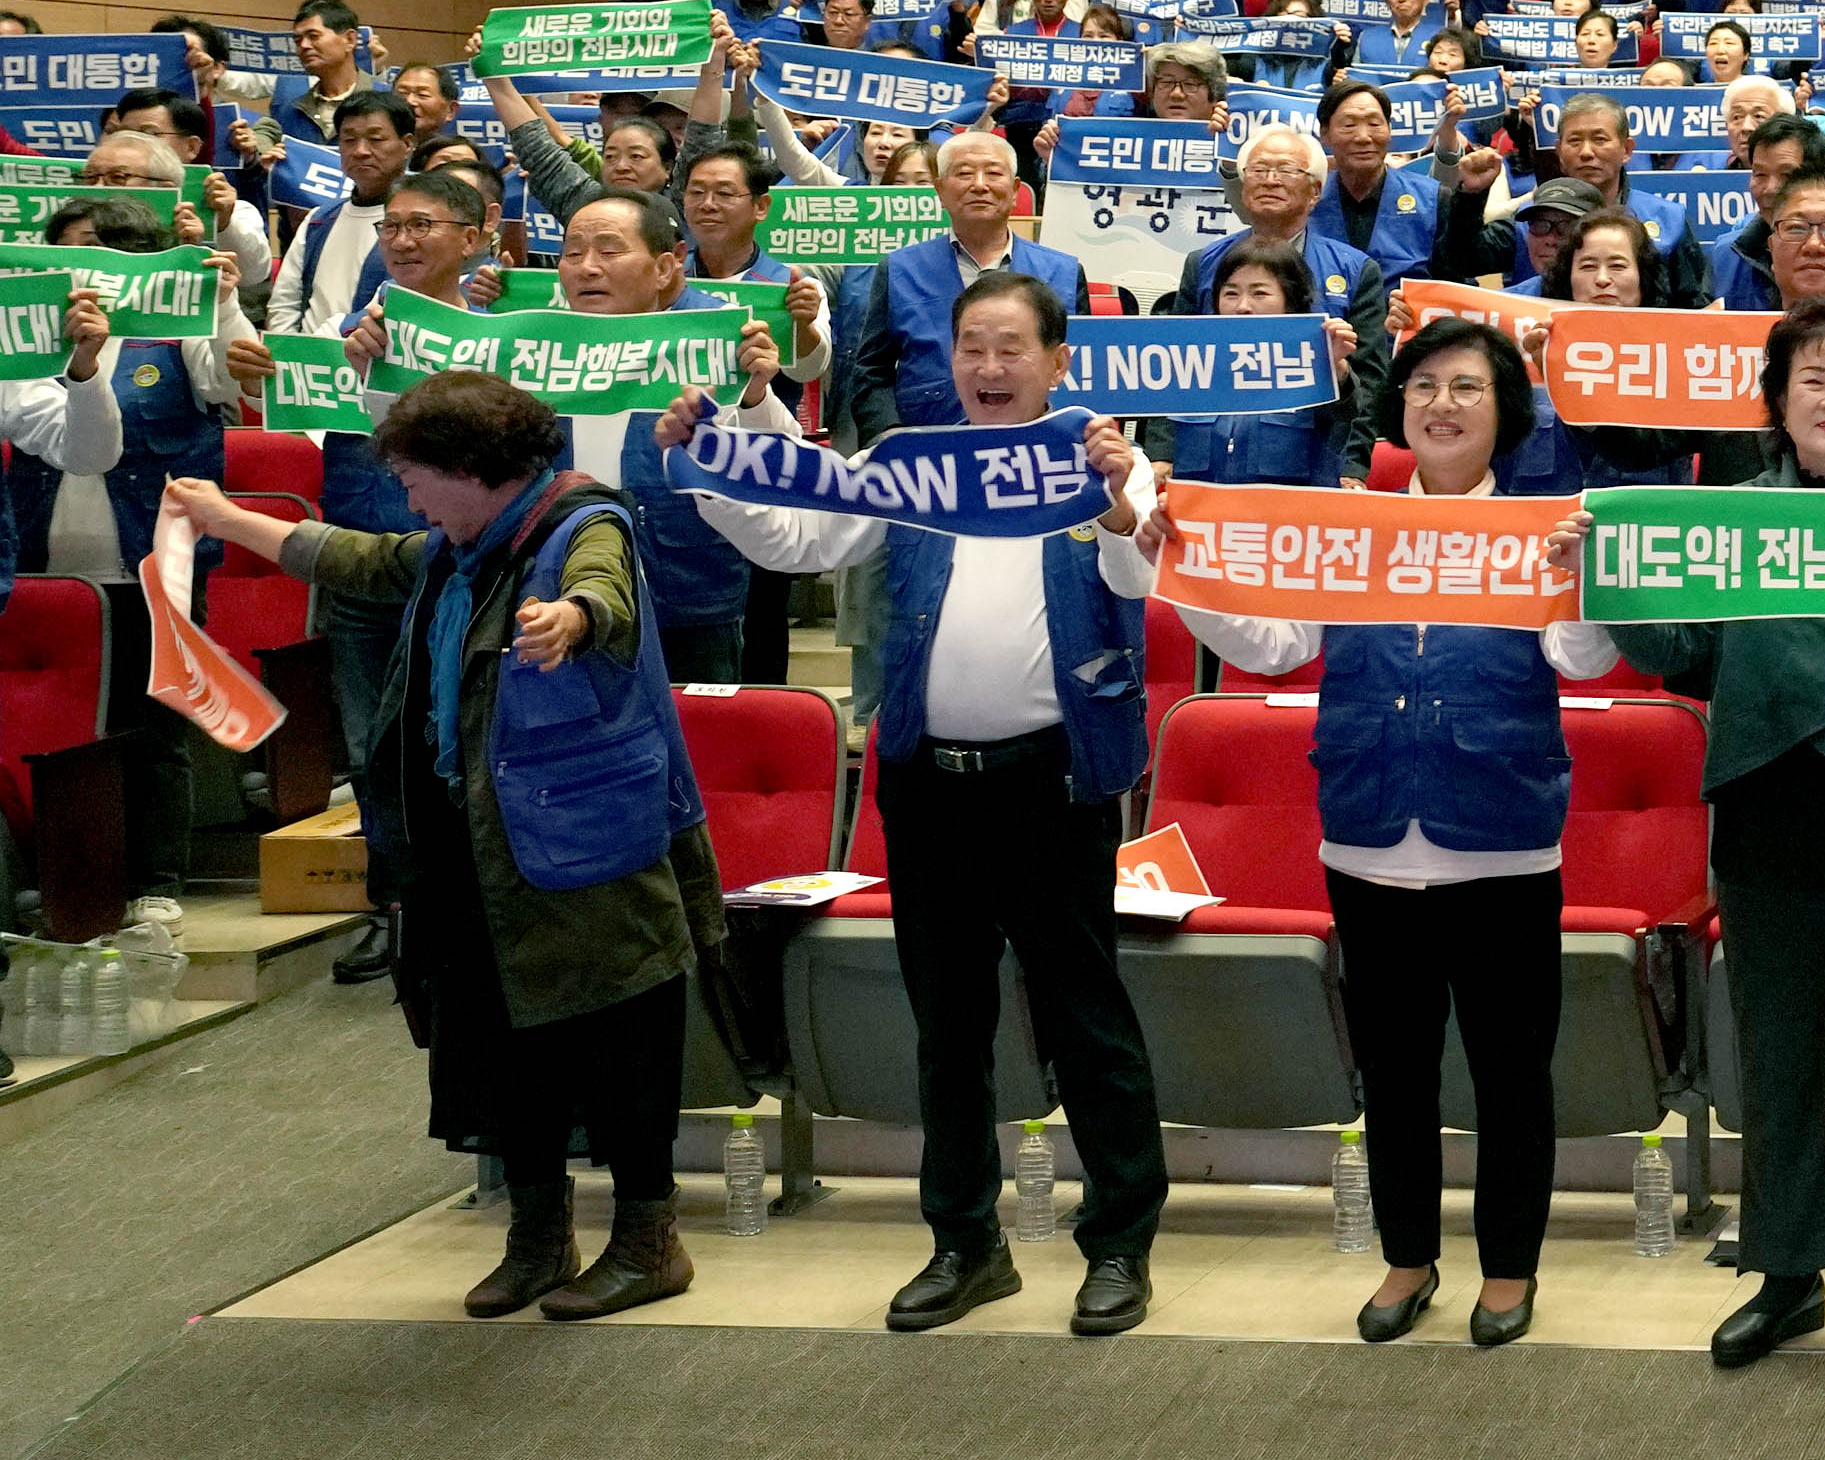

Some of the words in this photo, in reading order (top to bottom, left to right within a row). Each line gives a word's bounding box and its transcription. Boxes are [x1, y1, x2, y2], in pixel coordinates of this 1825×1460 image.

[523, 13, 592, 39] 새로운
[597, 8, 671, 34] 기회와
[48, 53, 160, 90] 대통합
[503, 37, 574, 65] 희망의
[581, 33, 678, 61] 전남시대
[778, 62, 851, 102] 도민
[856, 73, 965, 114] 대통합
[1079, 136, 1143, 170] 도민
[1151, 138, 1220, 173] 대통
[782, 196, 859, 223] 새로운
[866, 195, 944, 222] 기회와
[768, 228, 846, 255] 희망의
[510, 338, 737, 394] 전남행복시대!
[1106, 344, 1216, 390] NOW
[1229, 341, 1315, 389] 전남
[1564, 342, 1667, 399] 우리
[692, 420, 798, 492] OK!
[813, 449, 957, 512] NOW
[974, 444, 1089, 509] 전남
[1175, 519, 1372, 592] 교통안전
[1596, 523, 1742, 590] 대도약!
